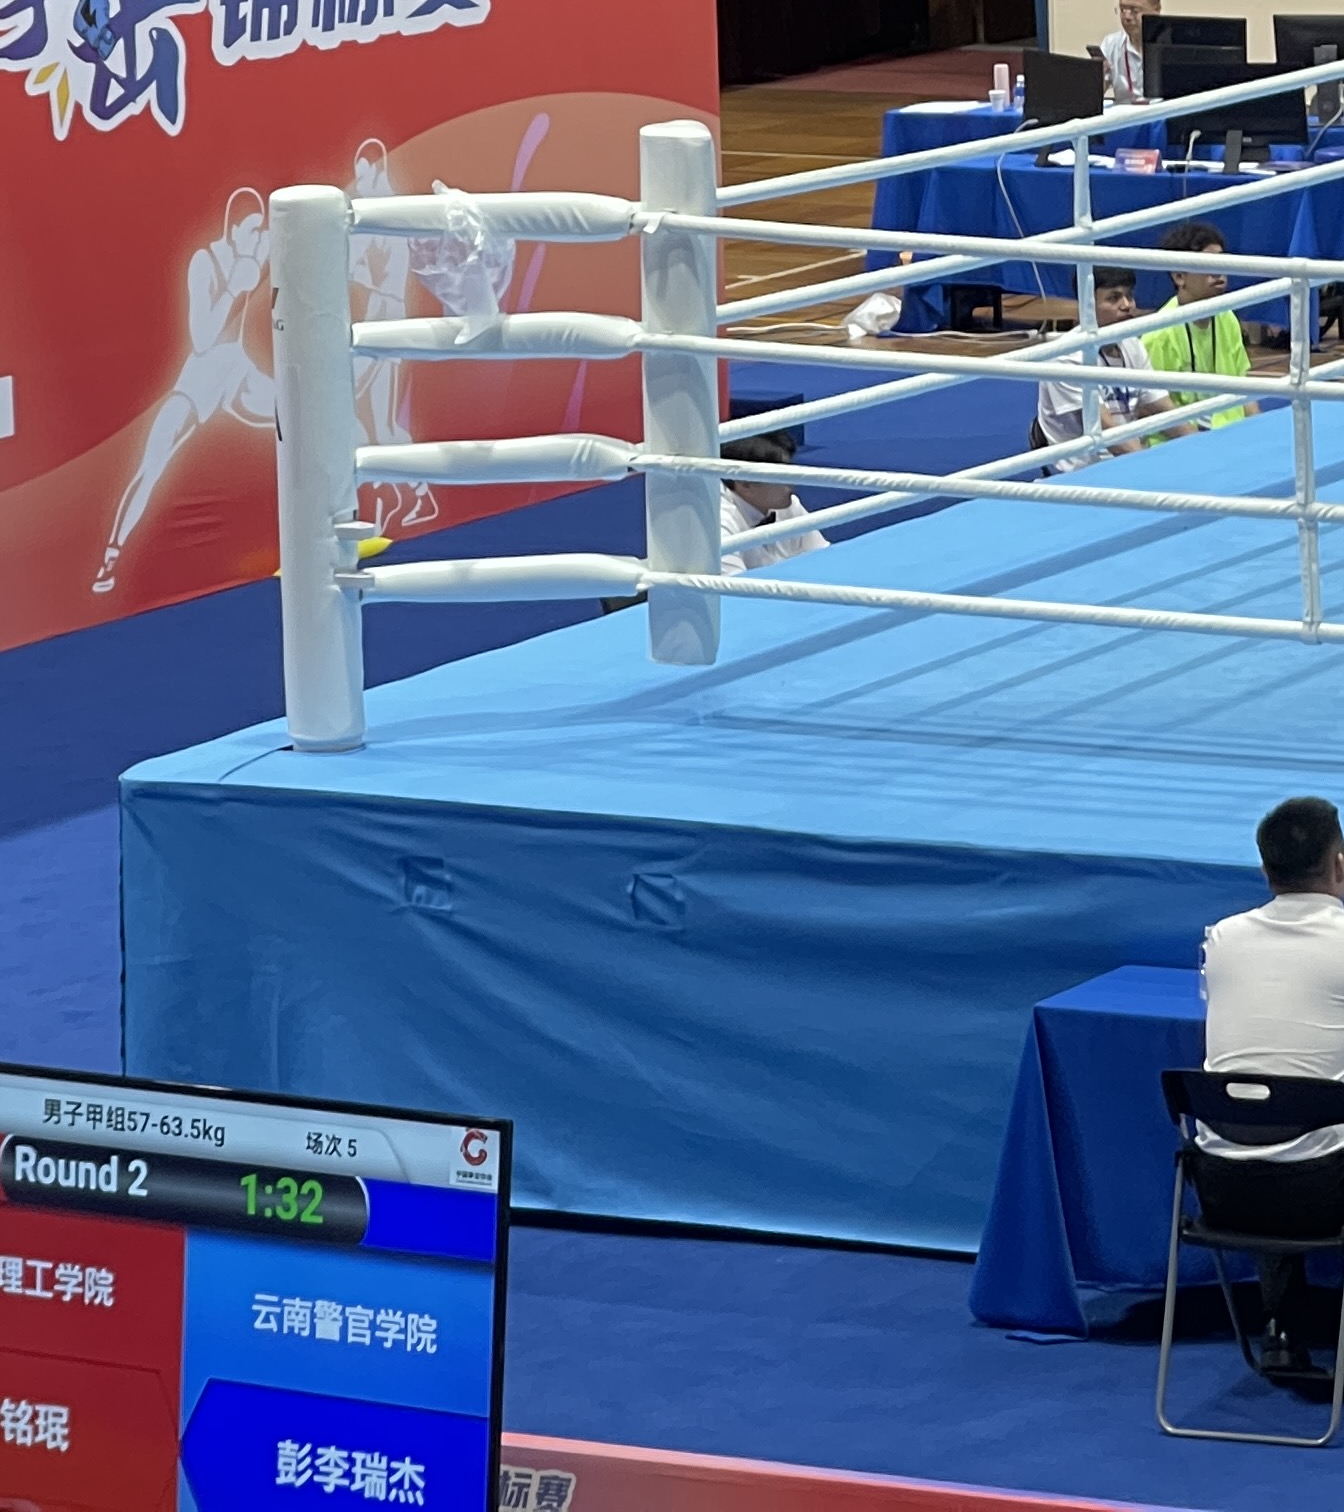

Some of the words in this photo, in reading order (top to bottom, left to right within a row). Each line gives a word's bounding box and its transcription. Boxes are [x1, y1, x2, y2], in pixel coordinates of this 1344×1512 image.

[42, 1097, 226, 1147] 男子甲组57-63.5kg
[305, 1131, 343, 1158] 场次
[347, 1138, 358, 1158] 5
[14, 1144, 119, 1193] Round
[127, 1159, 149, 1197] 2
[240, 1173, 324, 1225] 1:32
[0, 1255, 115, 1307] 理工学院
[251, 1292, 438, 1354] 云南警官学院
[276, 1438, 426, 1506] 彭李瑞杰
